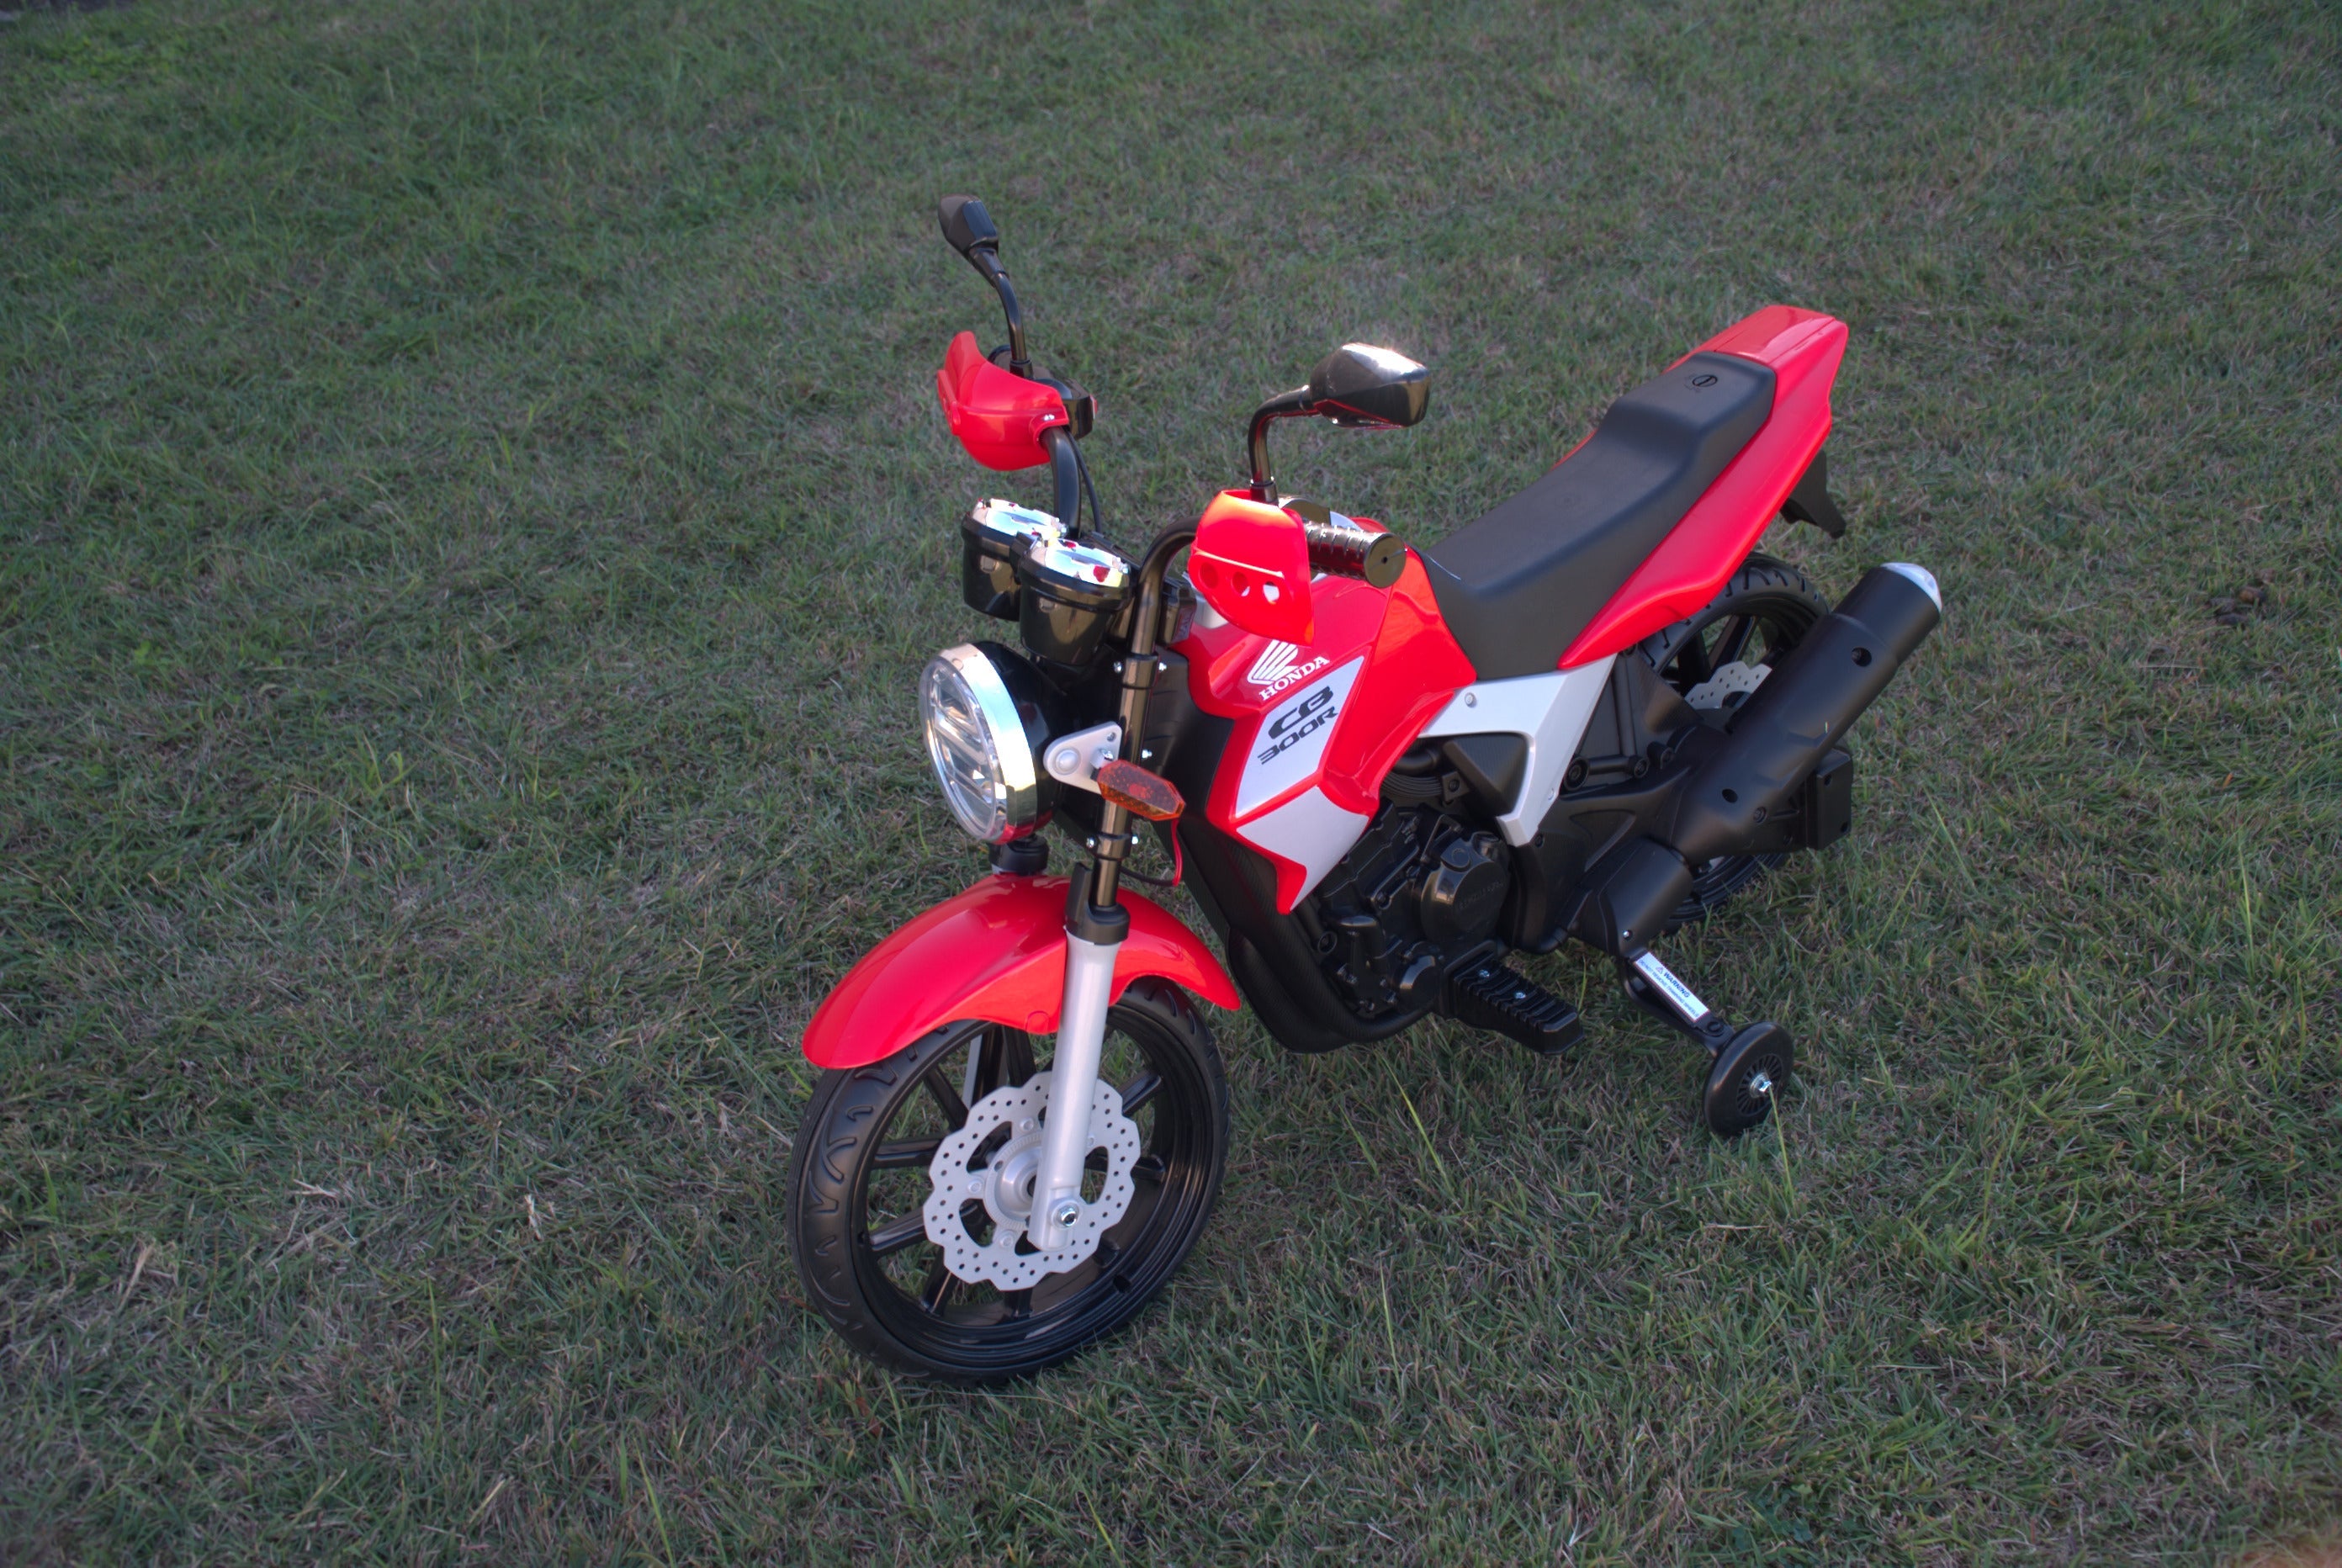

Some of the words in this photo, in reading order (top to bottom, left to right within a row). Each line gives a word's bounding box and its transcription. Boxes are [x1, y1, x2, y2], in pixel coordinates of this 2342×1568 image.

[1258, 656, 1330, 702] HONDA
[1257, 706, 1339, 765] 300R
[1268, 686, 1334, 740] CB
[1663, 972, 1690, 999] WARNING
